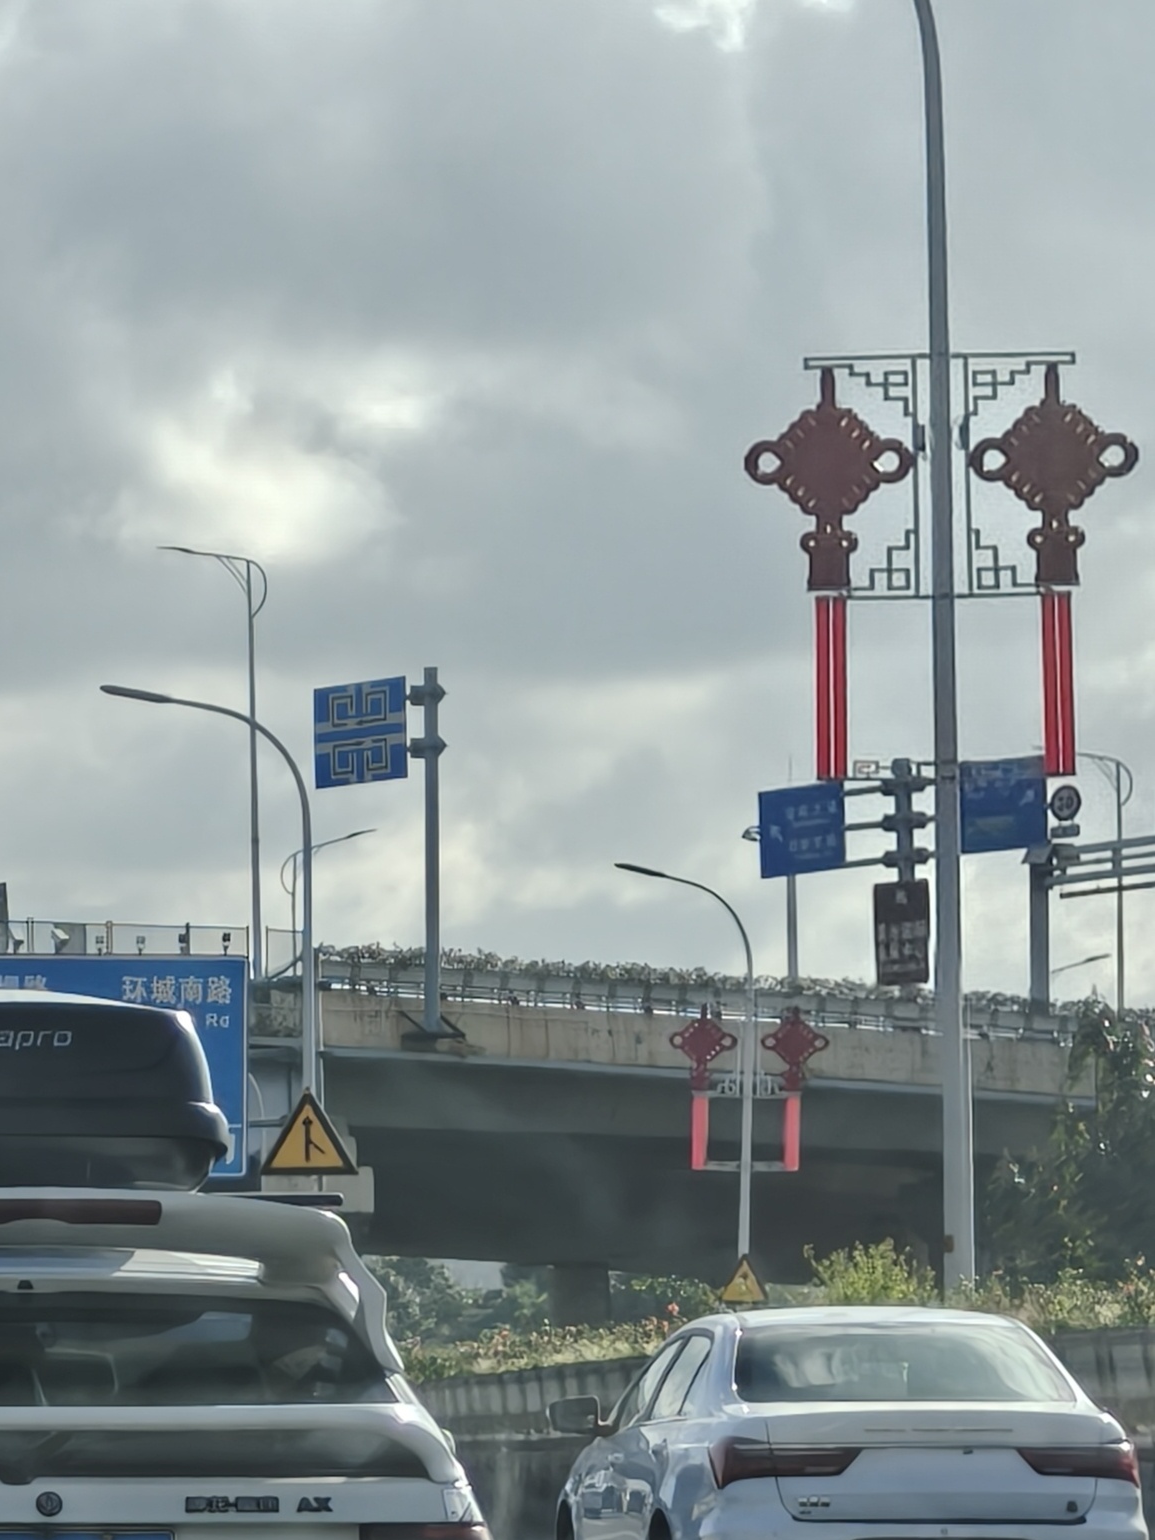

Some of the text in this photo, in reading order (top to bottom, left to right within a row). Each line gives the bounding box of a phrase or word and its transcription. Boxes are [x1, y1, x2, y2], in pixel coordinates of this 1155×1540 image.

[122, 975, 232, 1004] 环城南路
[206, 1013, 229, 1028] Rd
